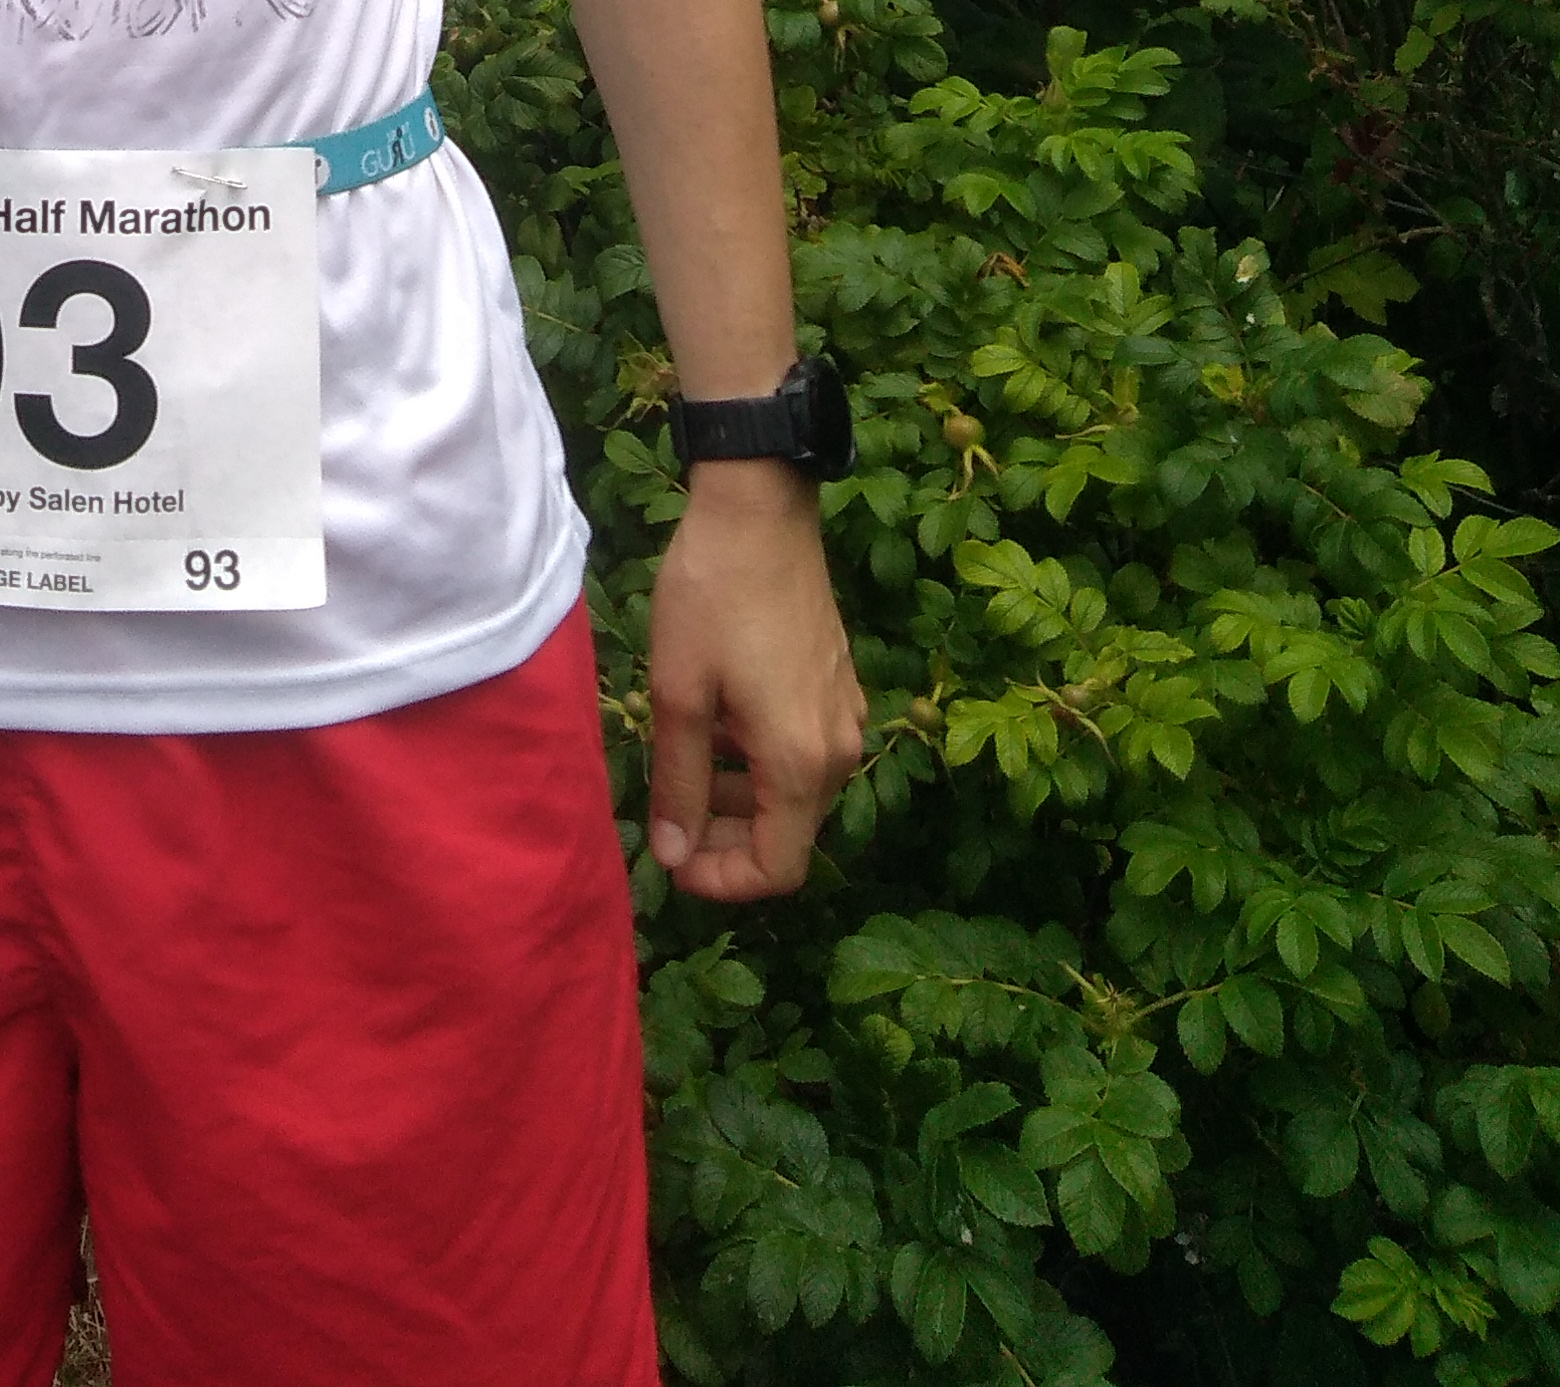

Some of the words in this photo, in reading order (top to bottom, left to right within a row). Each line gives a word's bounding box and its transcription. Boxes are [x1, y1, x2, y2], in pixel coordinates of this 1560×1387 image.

[80, 199, 271, 234] Marathon
[29, 486, 104, 514] Salen
[114, 489, 184, 514] Hotel
[26, 572, 94, 593] LABEL
[183, 549, 241, 592] 93
